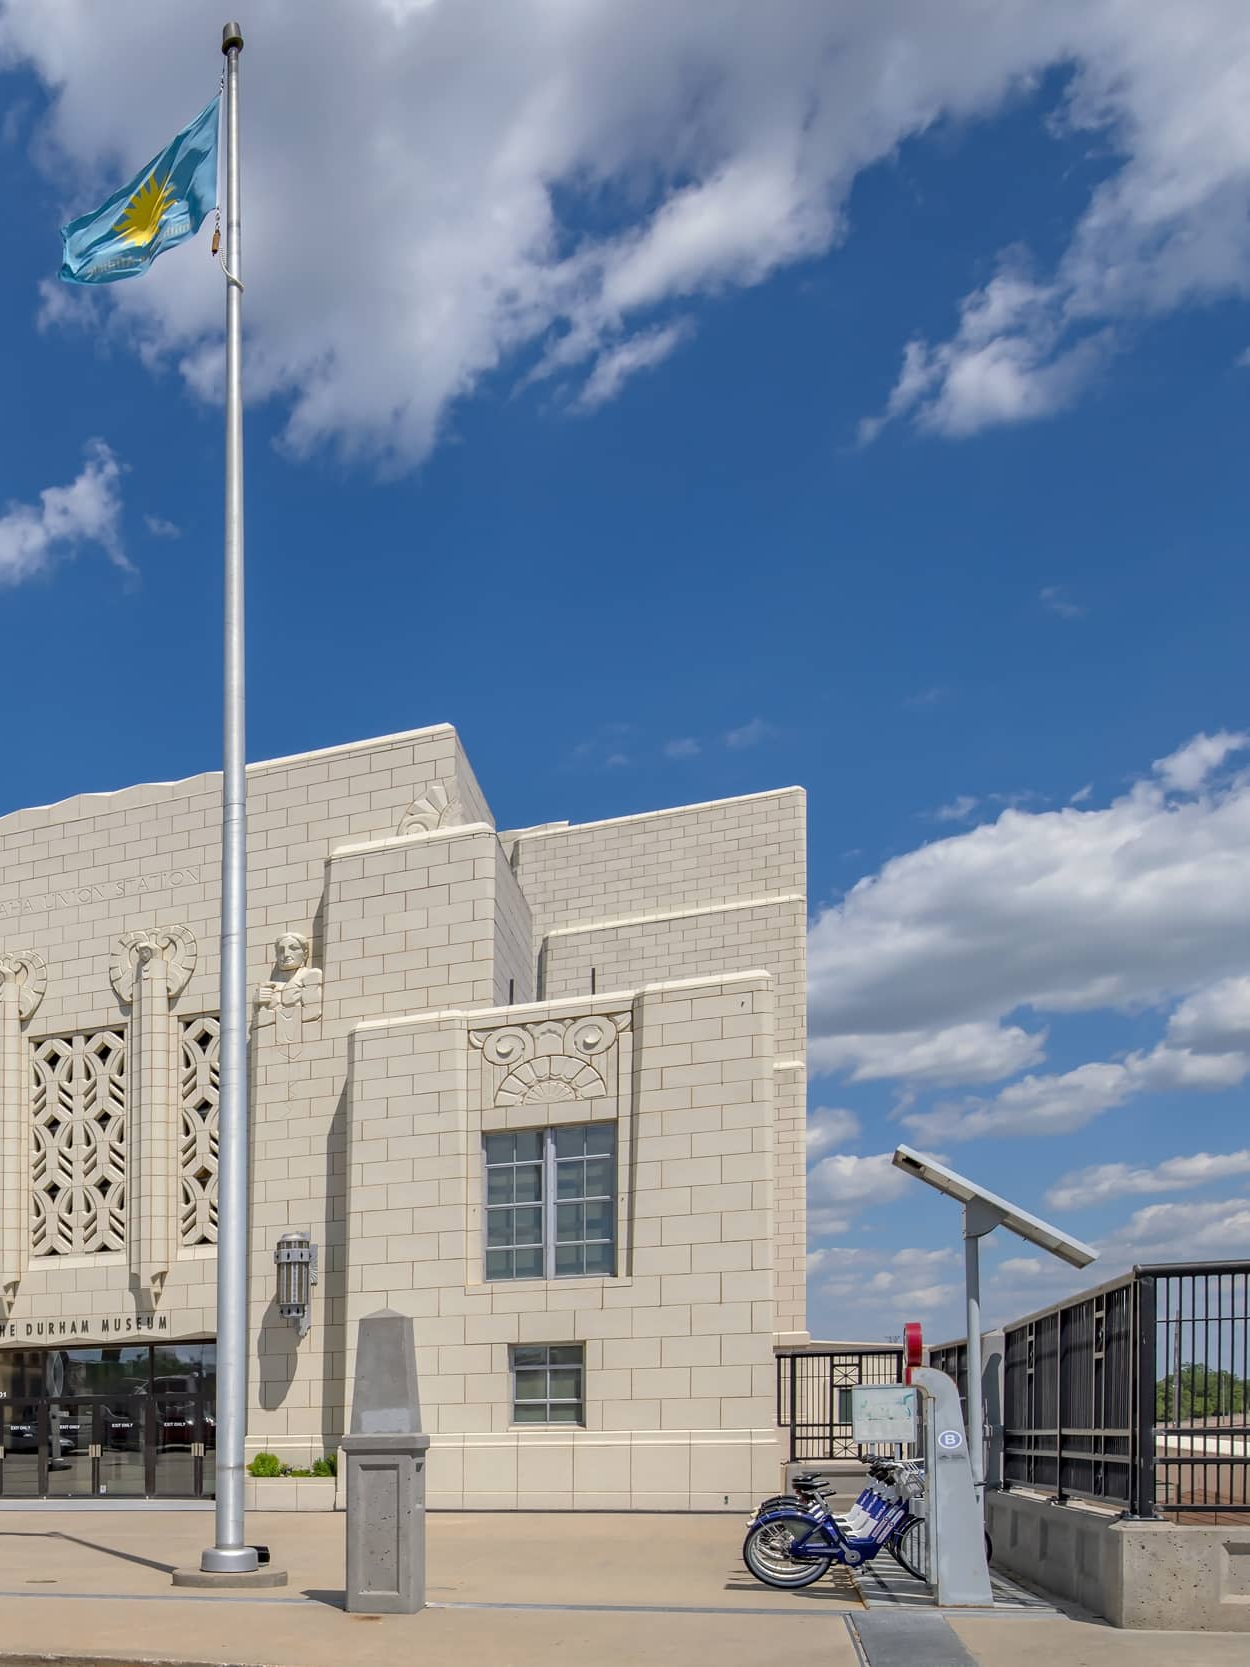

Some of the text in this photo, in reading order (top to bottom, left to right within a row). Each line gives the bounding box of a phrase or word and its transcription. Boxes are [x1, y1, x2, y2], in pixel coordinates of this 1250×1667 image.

[43, 885, 106, 909] UNION
[116, 867, 200, 897] STATION
[26, 1319, 90, 1336] DURHAM
[101, 1316, 167, 1333] MUSEUM
[944, 1434, 956, 1444] B
